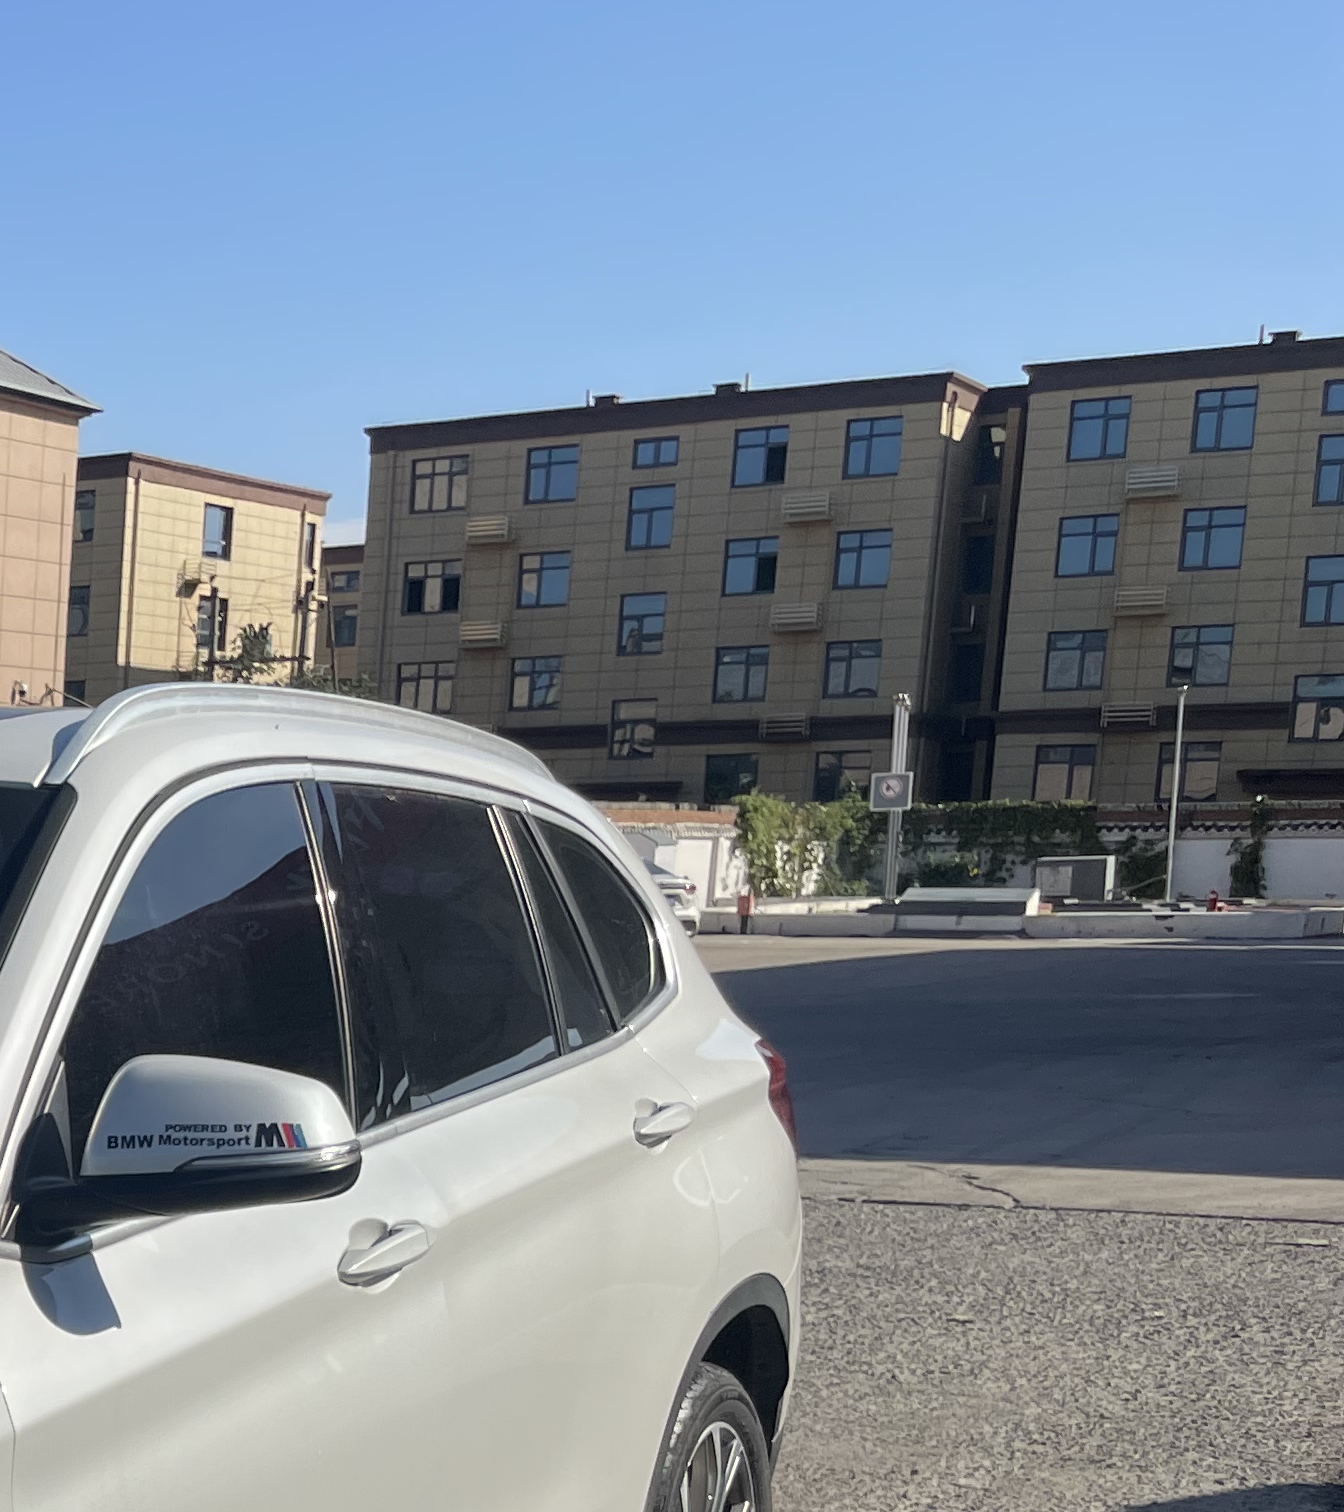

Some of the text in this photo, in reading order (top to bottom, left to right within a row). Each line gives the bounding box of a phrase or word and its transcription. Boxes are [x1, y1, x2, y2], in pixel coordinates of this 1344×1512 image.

[165, 1124, 252, 1133] POWERED BY
[107, 1134, 251, 1150] BMW Motorsport
